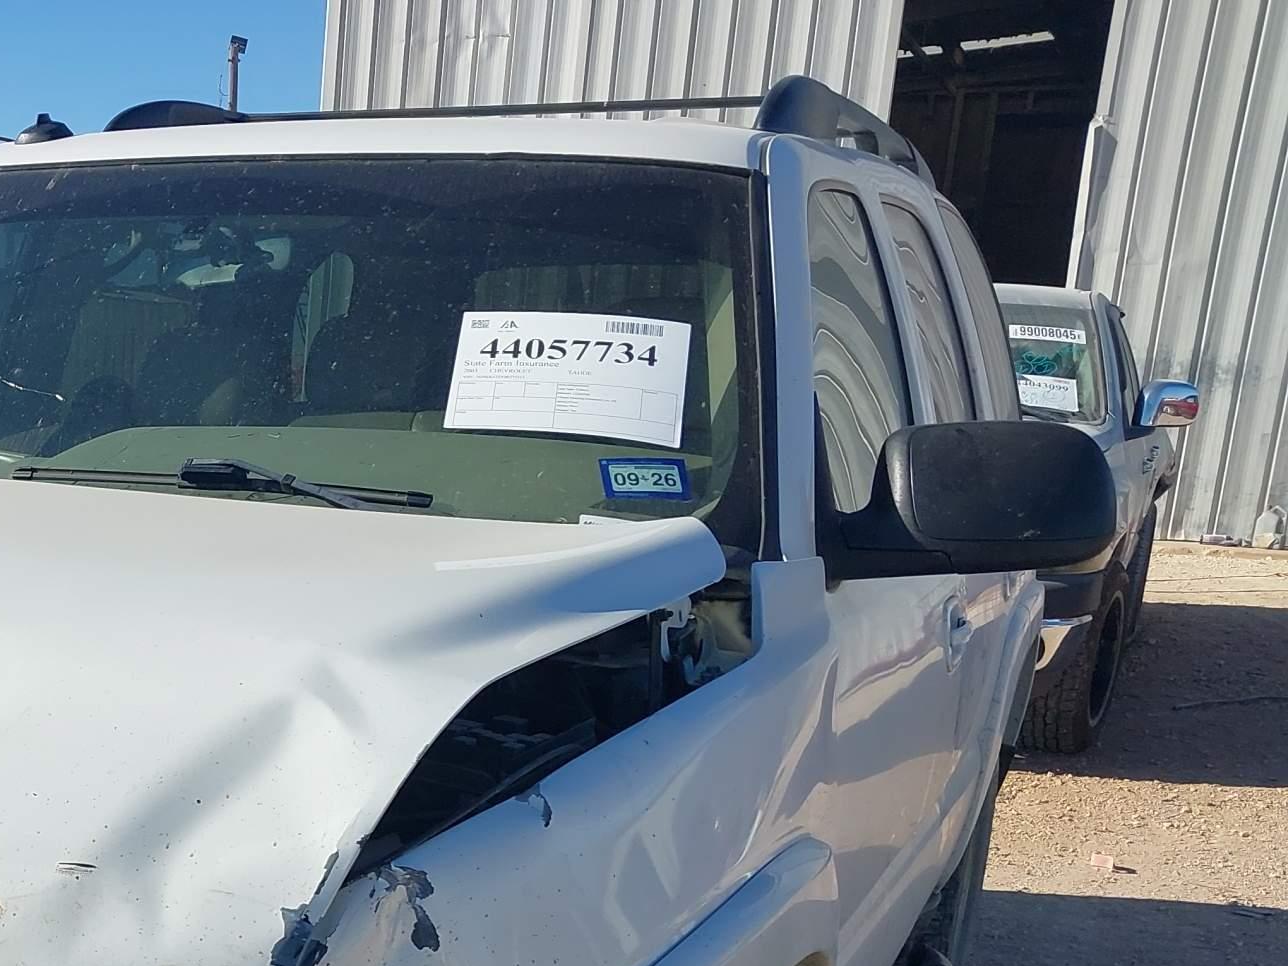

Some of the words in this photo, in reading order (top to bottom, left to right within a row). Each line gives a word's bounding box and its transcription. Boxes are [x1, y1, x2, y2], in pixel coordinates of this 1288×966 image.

[1019, 326, 1077, 340] 99008045
[479, 338, 658, 367] 44057734
[464, 359, 487, 367] State
[515, 360, 560, 368] Insurance
